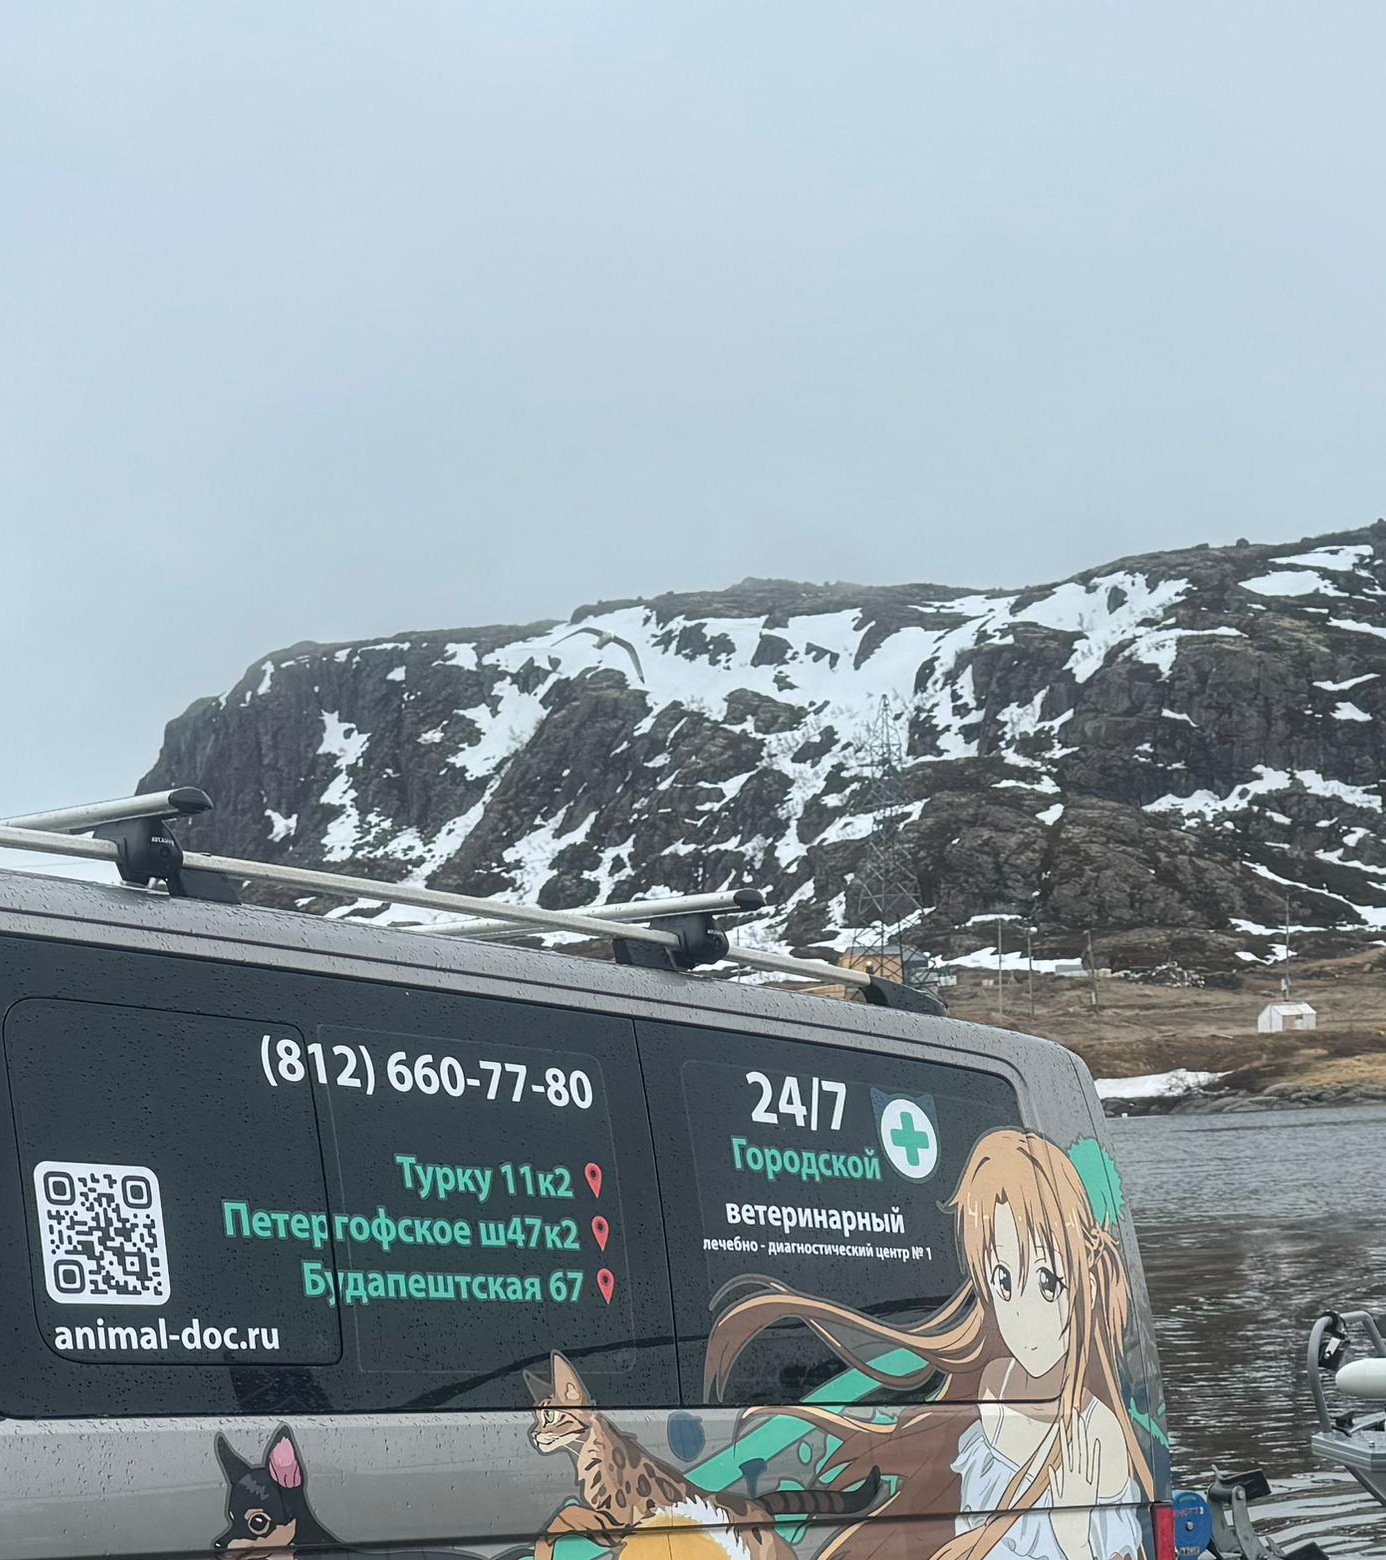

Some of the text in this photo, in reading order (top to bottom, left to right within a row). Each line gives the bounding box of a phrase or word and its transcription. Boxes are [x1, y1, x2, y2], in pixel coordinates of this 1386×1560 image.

[260, 1034, 593, 1109] (812) 660-77-80
[745, 1071, 847, 1131] 24/7
[396, 1155, 573, 1201] Турку 11к2
[732, 1138, 881, 1181] Городской
[224, 1202, 580, 1251] Петергофское ш47к2
[725, 1203, 905, 1238] ветеринарный
[702, 1235, 759, 1253] лечебно
[767, 1241, 874, 1258] диагностический
[875, 1246, 910, 1263] центр
[925, 1246, 932, 1261] 1
[303, 1262, 583, 1306] Будапештская 67
[54, 1317, 280, 1350] animal-doc.ru
